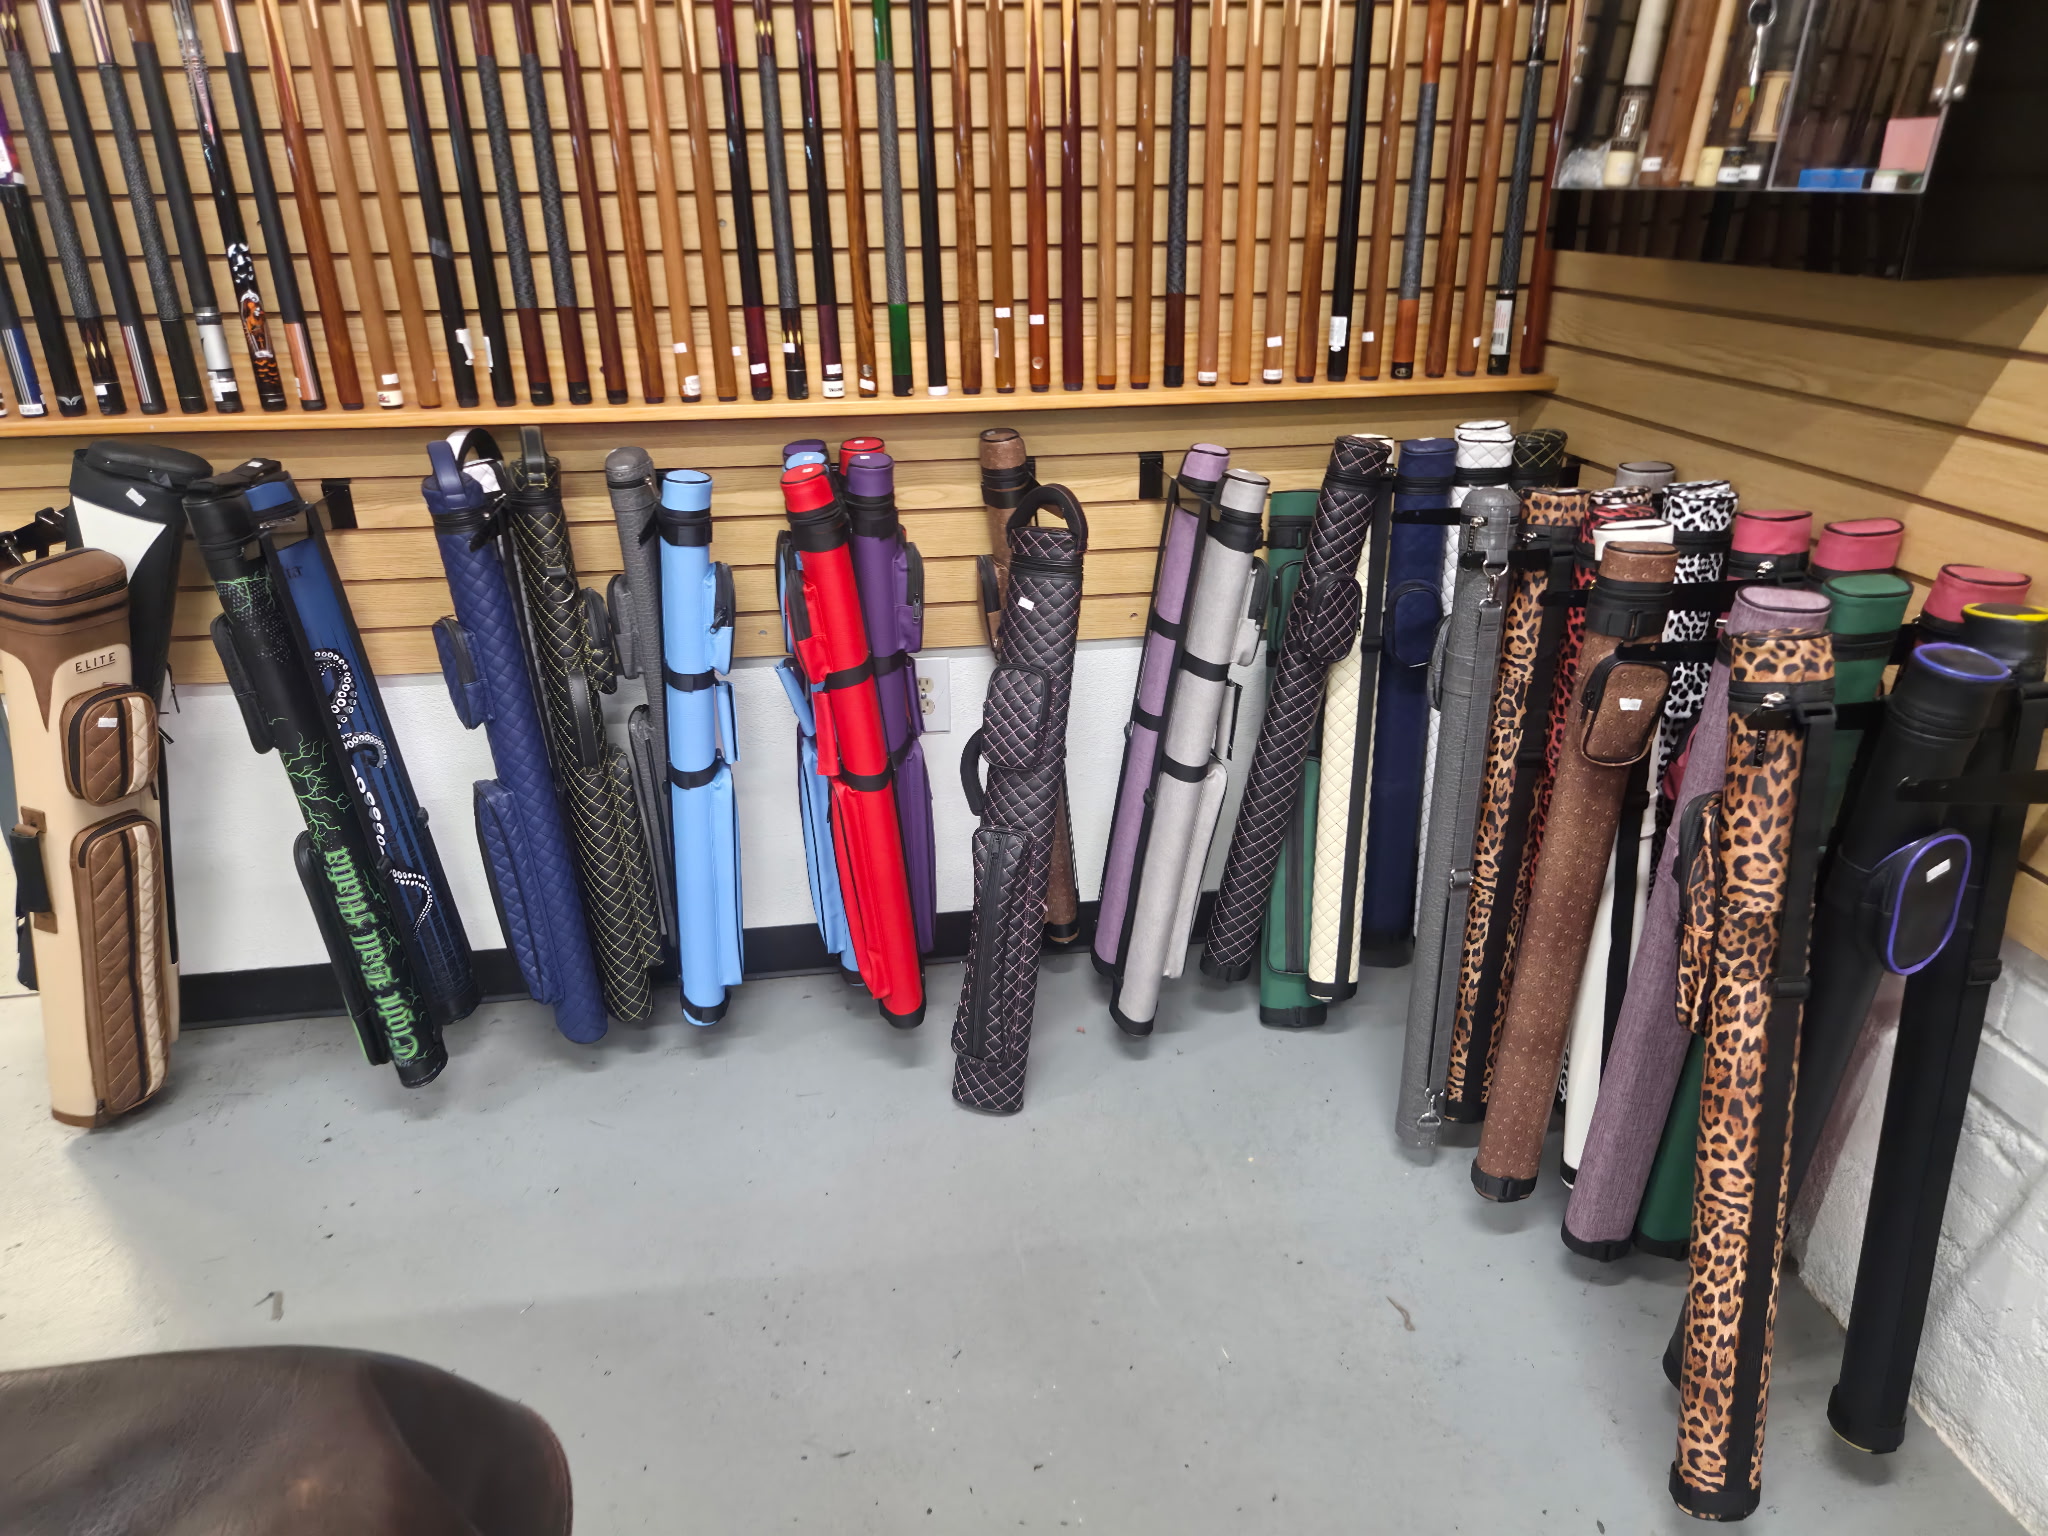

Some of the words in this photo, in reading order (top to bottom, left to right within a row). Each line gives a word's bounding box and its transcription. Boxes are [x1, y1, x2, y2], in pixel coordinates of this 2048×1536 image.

[75, 652, 115, 672] ELITE
[324, 846, 378, 928] Mafia
[350, 930, 399, 992] Ball
[374, 991, 418, 1060] Eight
